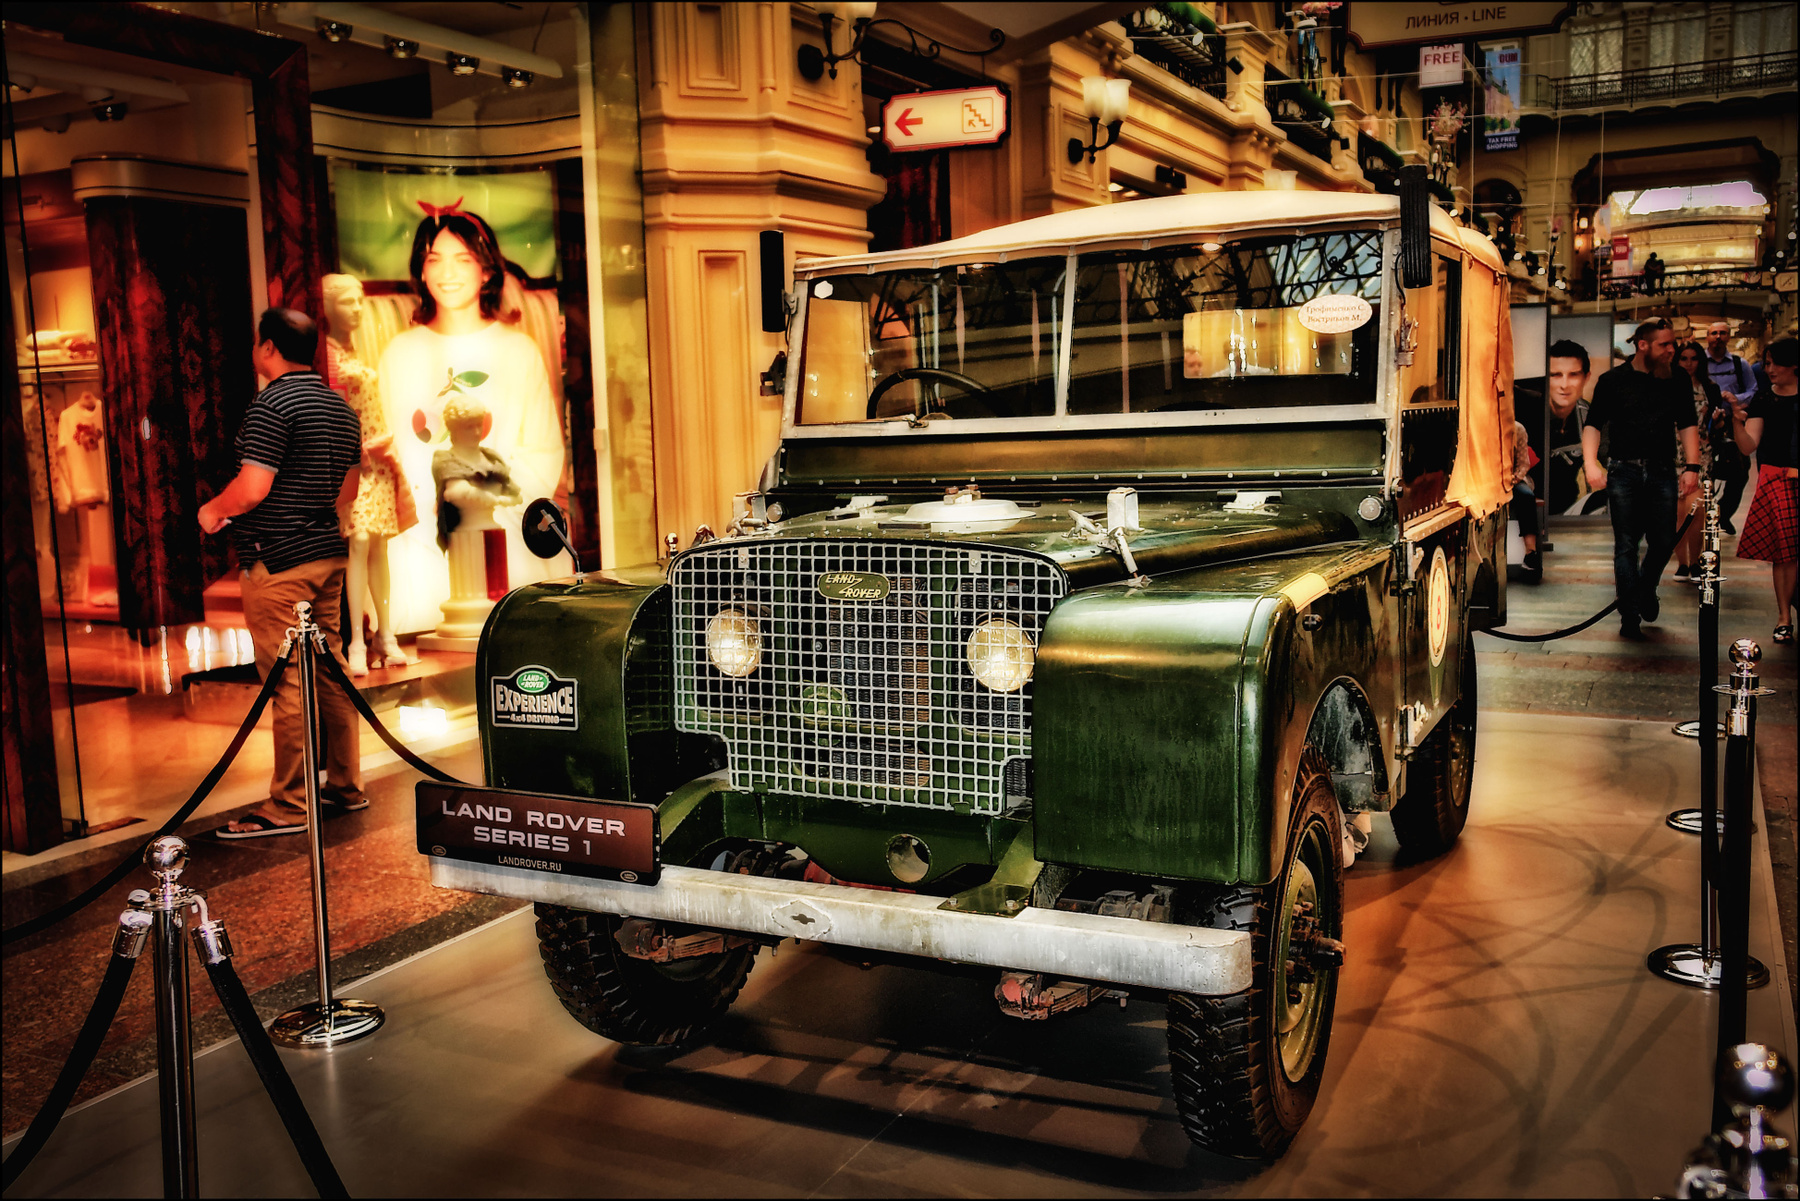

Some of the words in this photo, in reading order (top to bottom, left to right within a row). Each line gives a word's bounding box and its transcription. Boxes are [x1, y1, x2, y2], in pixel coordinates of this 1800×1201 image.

[1405, 11, 1459, 29] ЛИНИЯ
[1472, 6, 1507, 22] LINE
[1424, 51, 1460, 66] FREE
[1486, 142, 1517, 150] SHOPPING
[825, 574, 855, 584] LAND
[845, 588, 881, 598] ROVER
[523, 674, 540, 682] LAND
[524, 681, 544, 689] ROVER
[496, 685, 573, 714] EXPERIENCE
[510, 713, 526, 723] 4x4
[526, 714, 559, 724] DRIVING
[442, 800, 512, 823] LAND
[526, 810, 626, 837] ROVER
[473, 825, 570, 853] SERIES
[582, 840, 591, 856] 1
[498, 855, 562, 872] LANDROVER.RU
